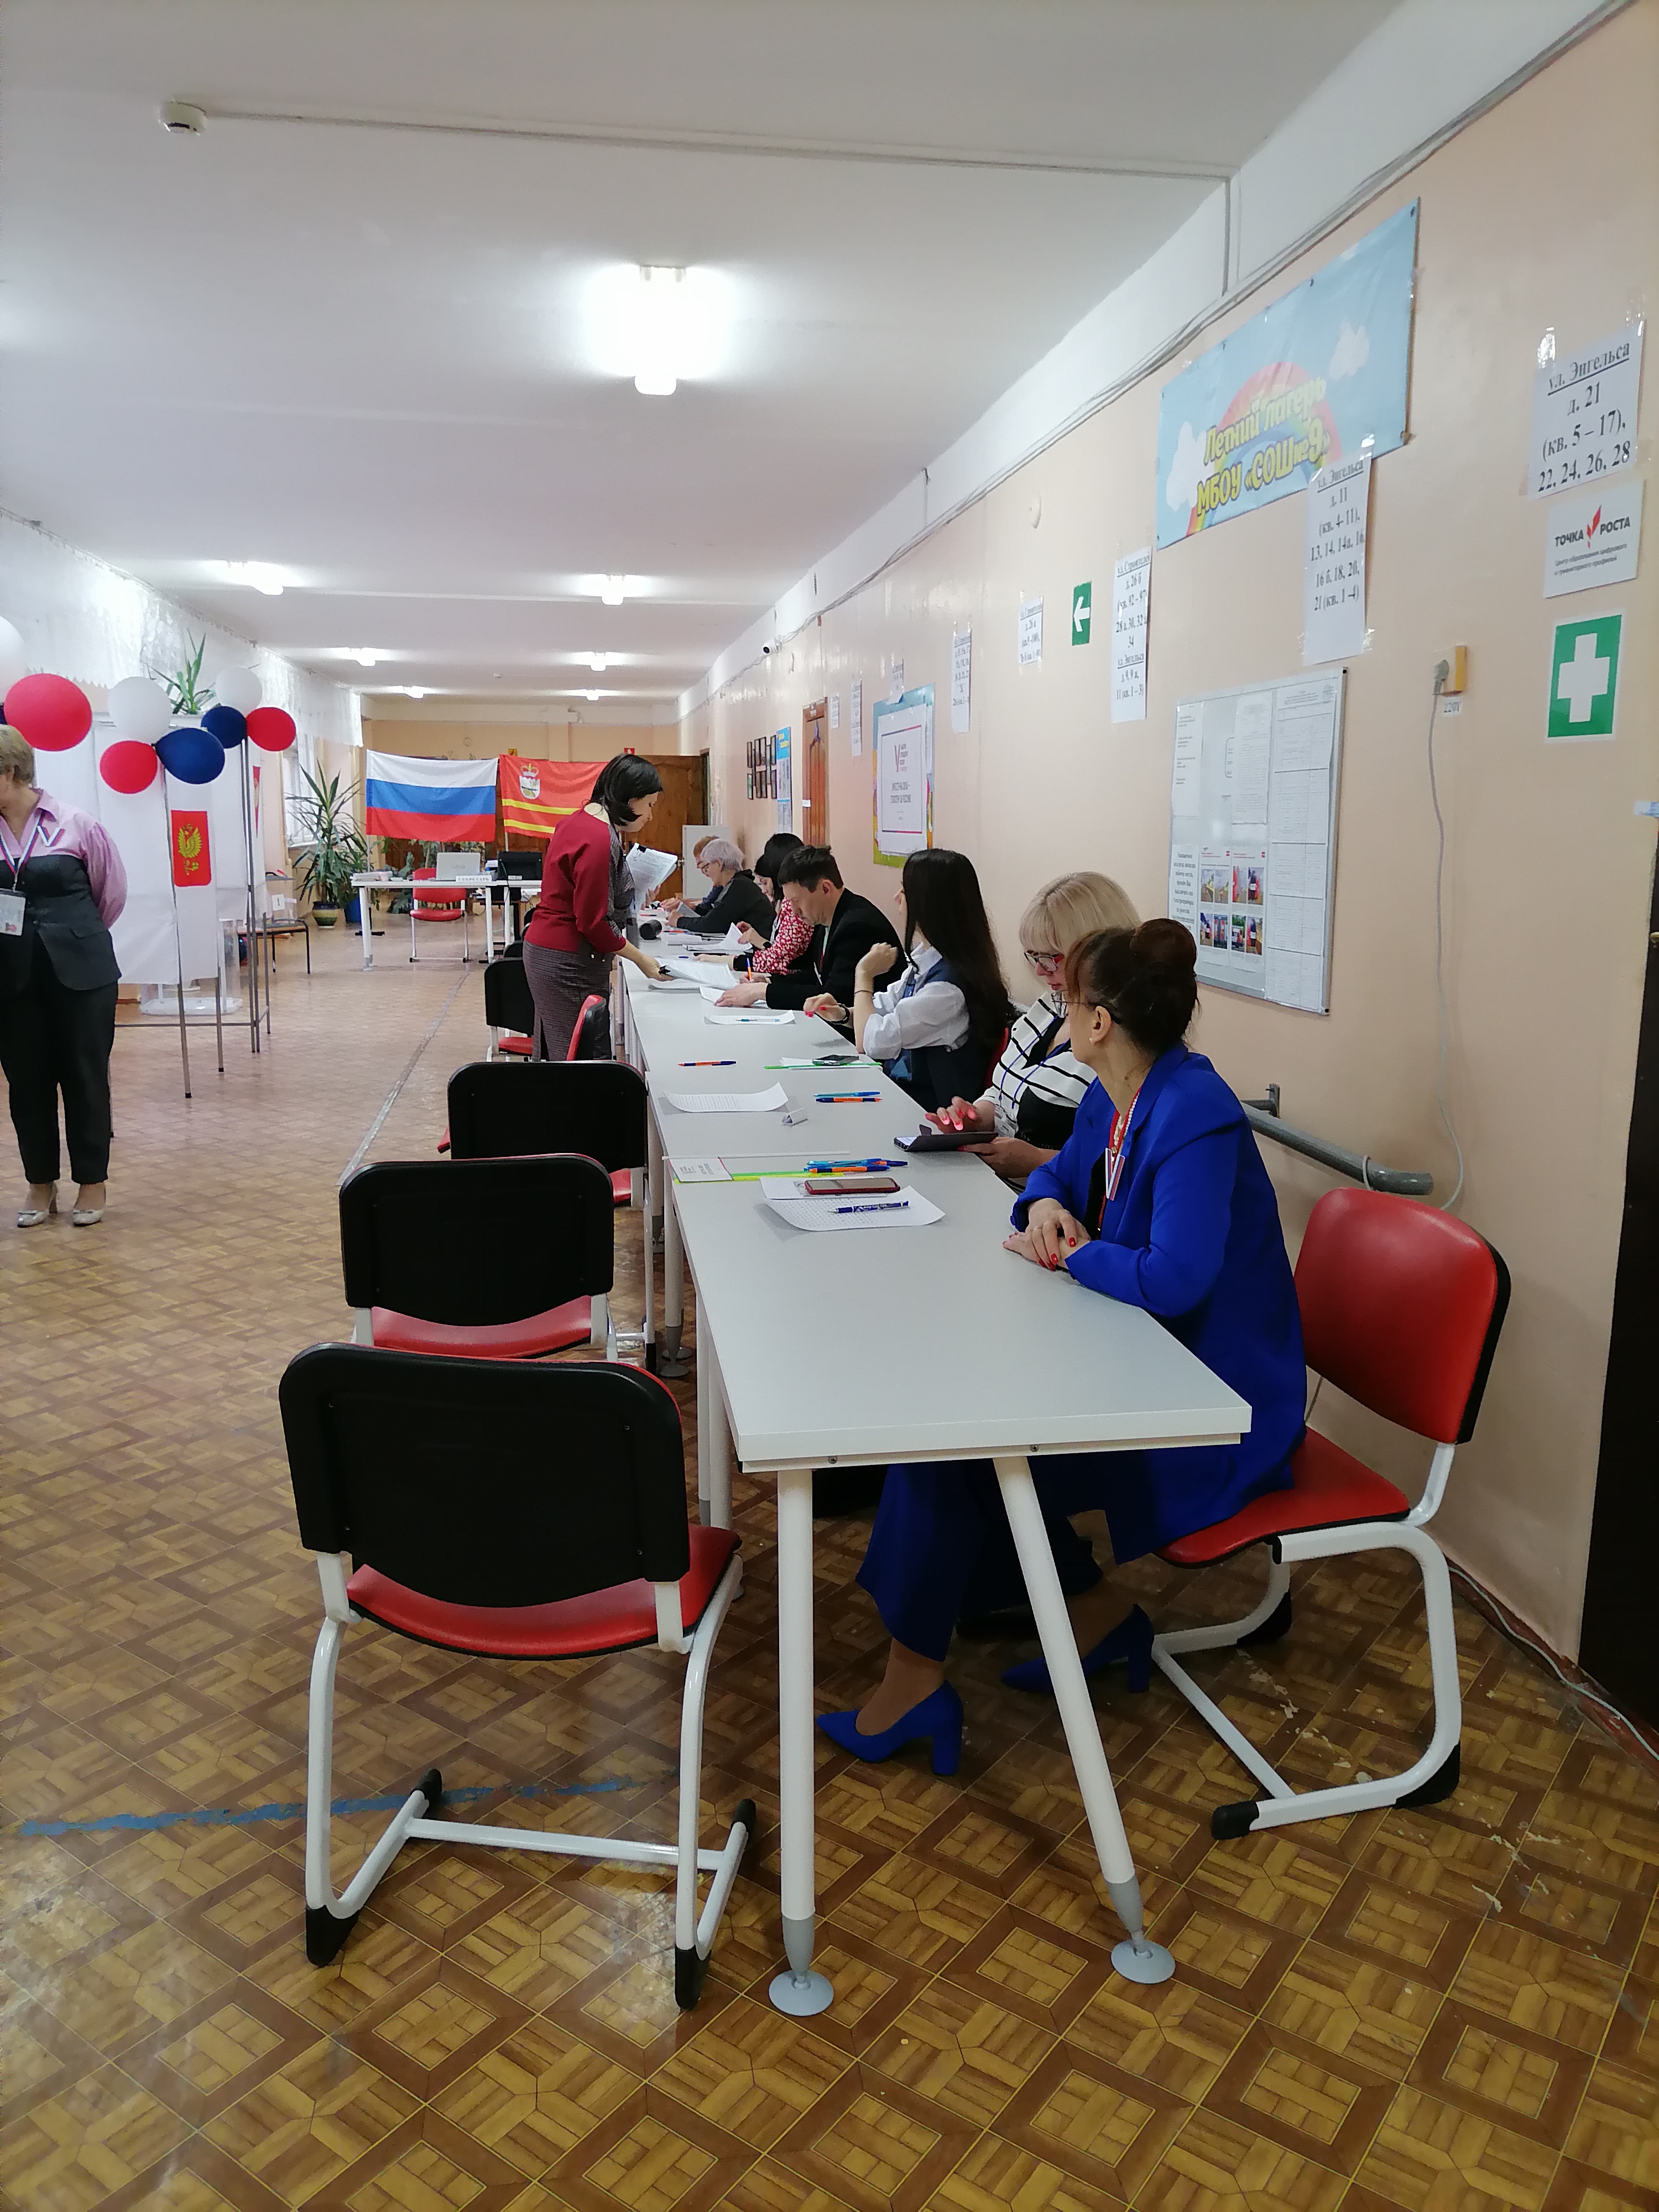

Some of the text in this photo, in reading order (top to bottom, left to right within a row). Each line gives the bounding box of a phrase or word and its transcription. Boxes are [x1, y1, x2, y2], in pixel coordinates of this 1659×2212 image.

[1549, 343, 1630, 390] ул. Энгельса
[1567, 382, 1600, 416] д. 21
[1203, 397, 1261, 466] Летний
[1542, 437, 1568, 462] (кв.
[1572, 424, 1581, 446] 5
[1538, 440, 1631, 492] 22, 24, 26, 28
[1197, 461, 1243, 517] МБОУ
[1339, 487, 1347, 504] 11
[1554, 515, 1631, 547] ТОЧКА РОСТА
